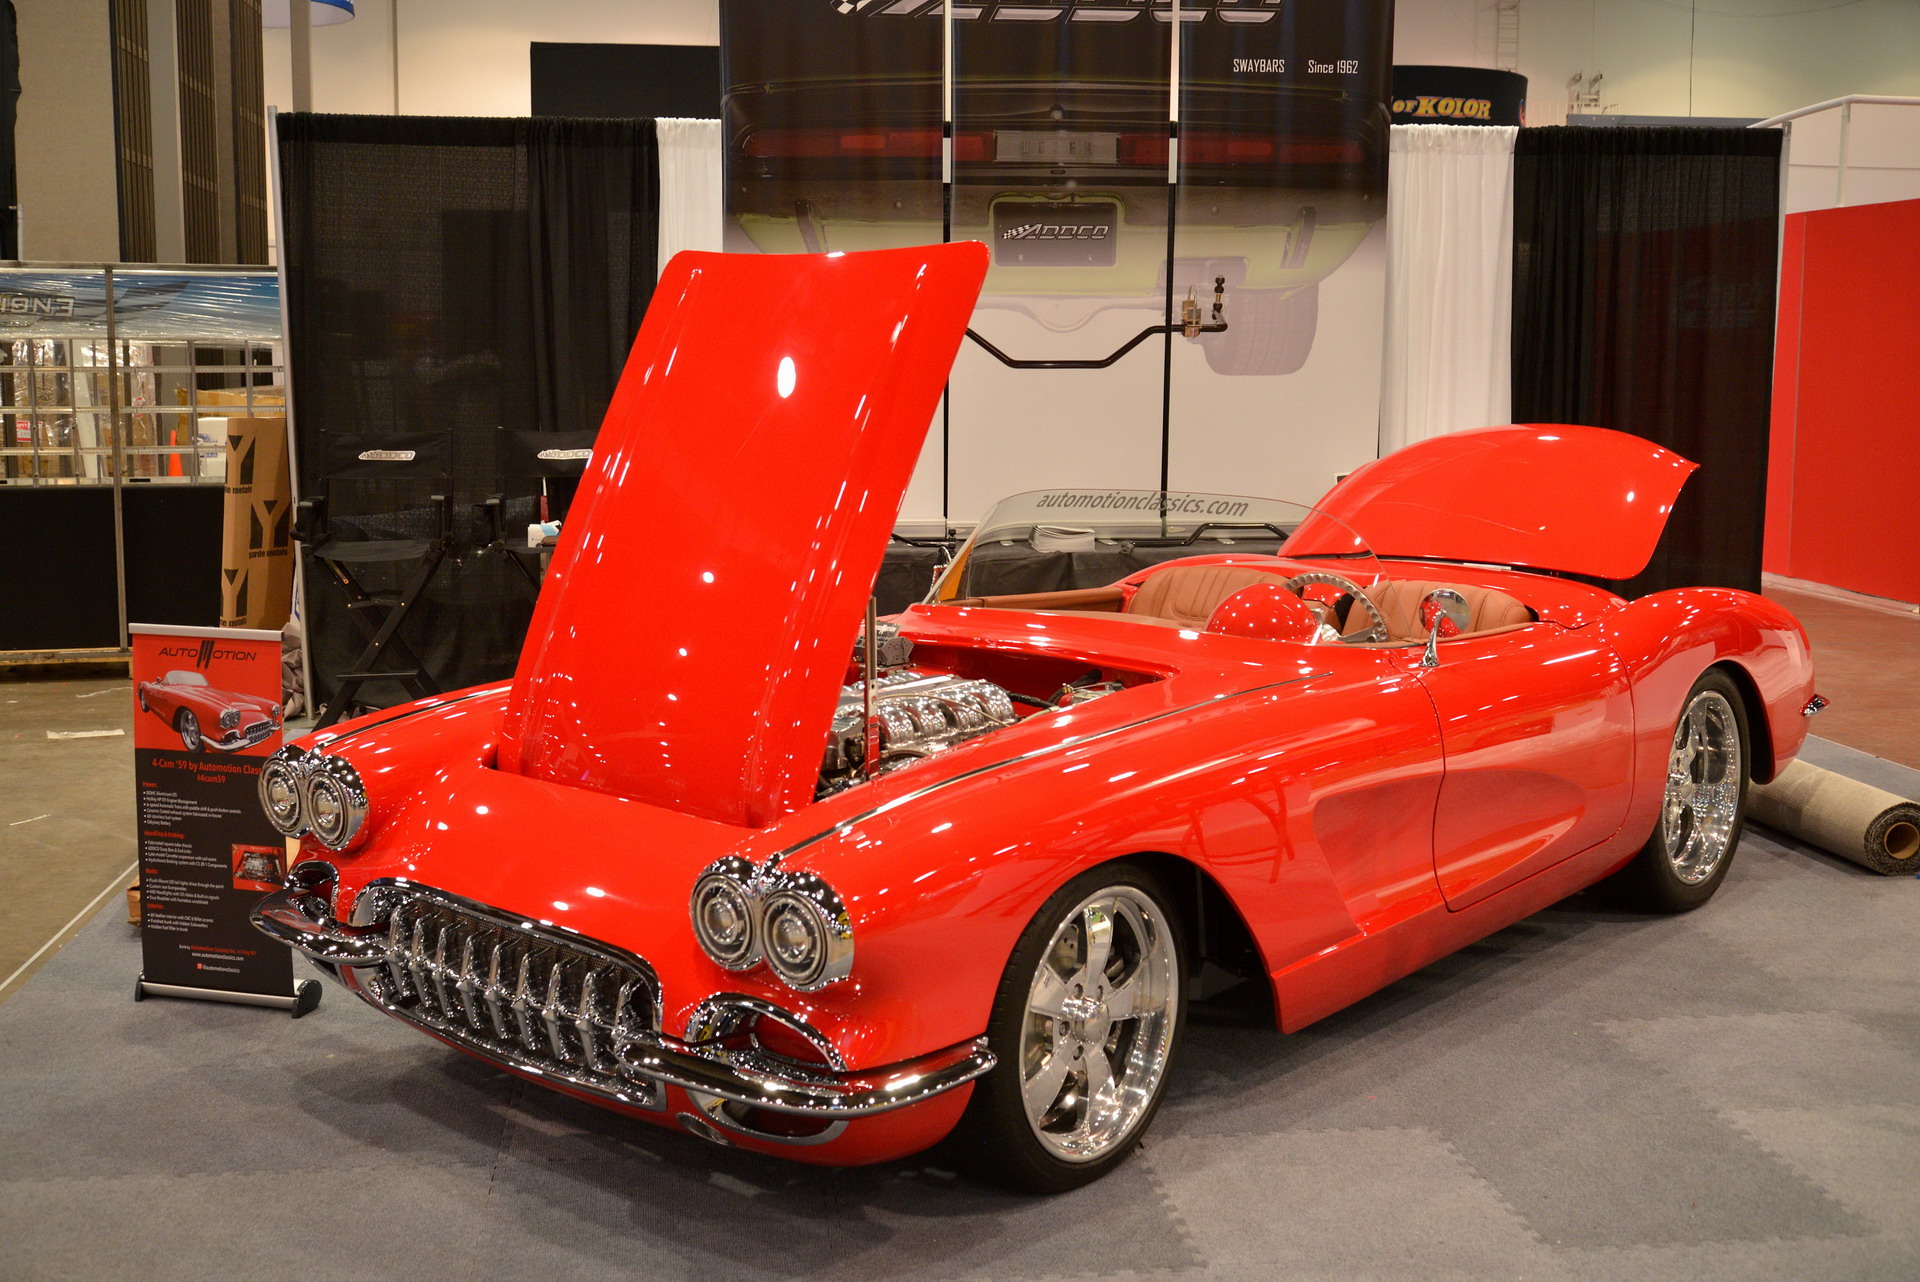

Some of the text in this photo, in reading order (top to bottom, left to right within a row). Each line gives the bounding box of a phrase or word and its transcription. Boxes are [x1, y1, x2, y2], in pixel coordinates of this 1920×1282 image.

[1233, 58, 1359, 74] SWAYBARS Since 1962
[1412, 96, 1491, 120] KOLOR
[1036, 491, 1249, 517] automotionclassics.com
[152, 758, 174, 769] 4-Cam
[188, 760, 197, 773] by
[200, 762, 242, 773] Automotion
[243, 764, 262, 775] Class
